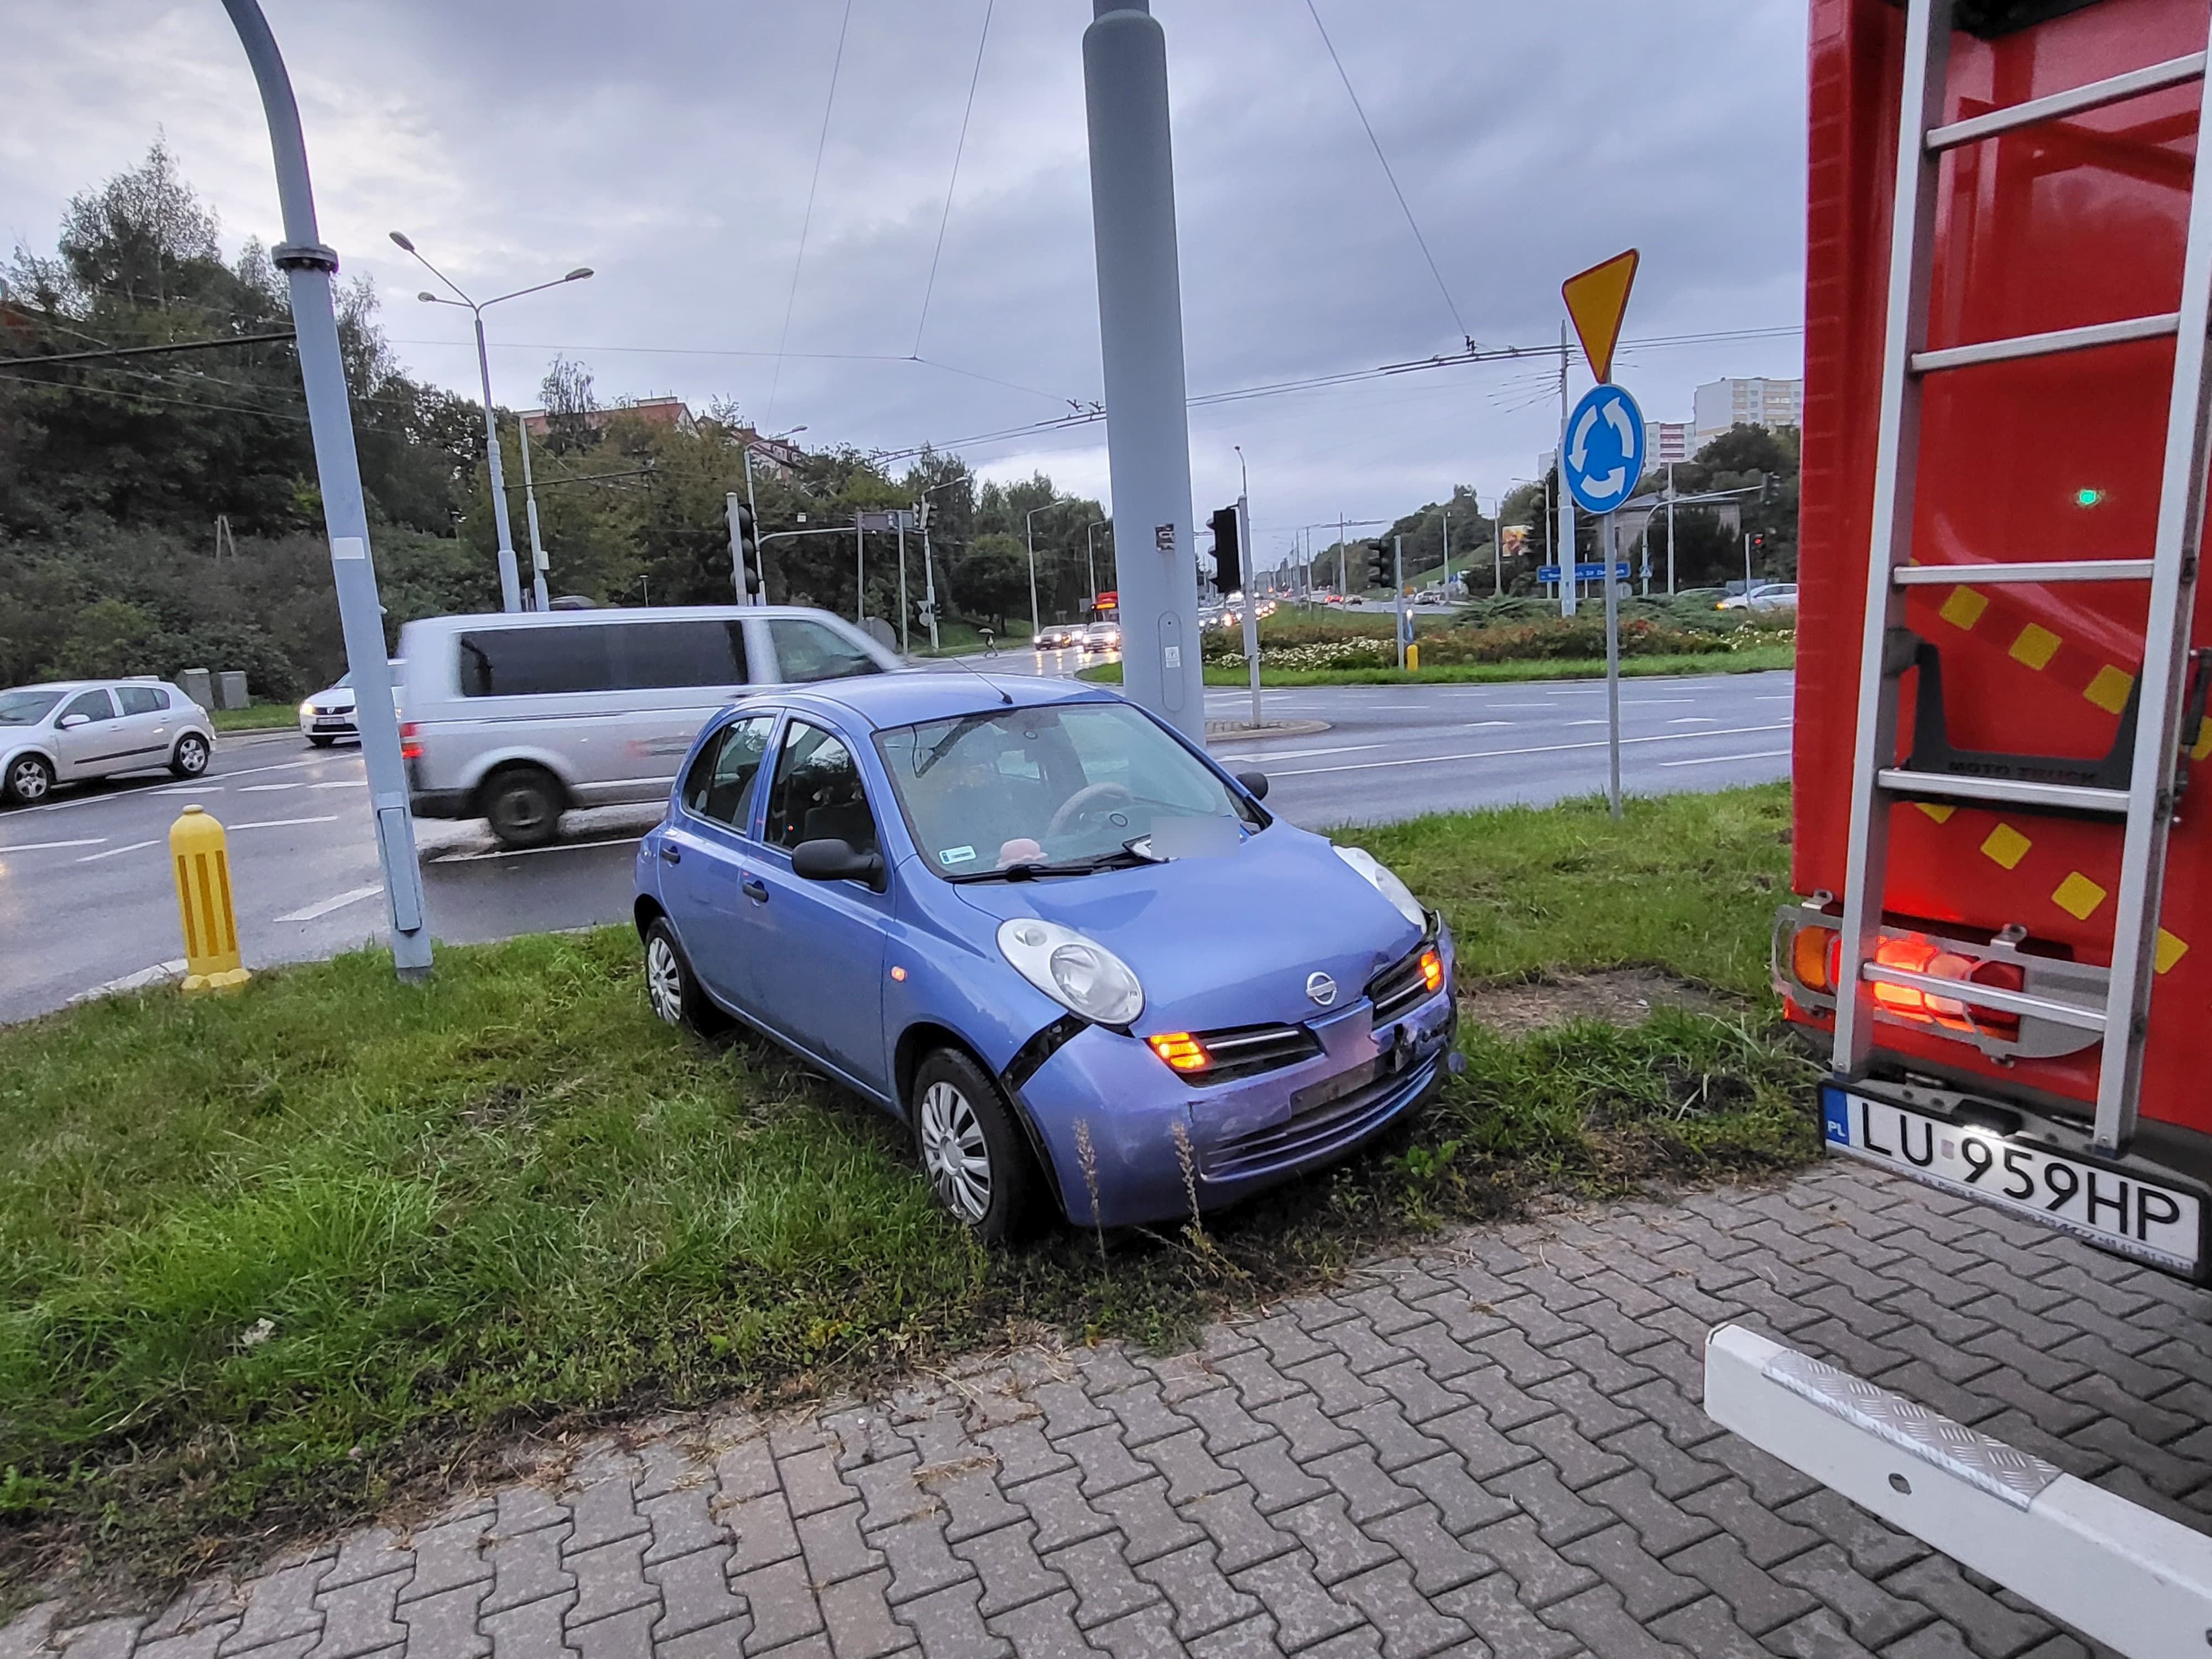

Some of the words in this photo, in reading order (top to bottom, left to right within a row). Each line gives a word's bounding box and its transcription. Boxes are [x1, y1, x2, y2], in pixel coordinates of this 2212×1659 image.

[1948, 761, 2010, 775] MOTO
[2017, 766, 2099, 783] TRUCK
[1827, 1120, 1846, 1138] PL
[1862, 1102, 1933, 1167] LU
[1961, 1136, 2180, 1241] 959HP
